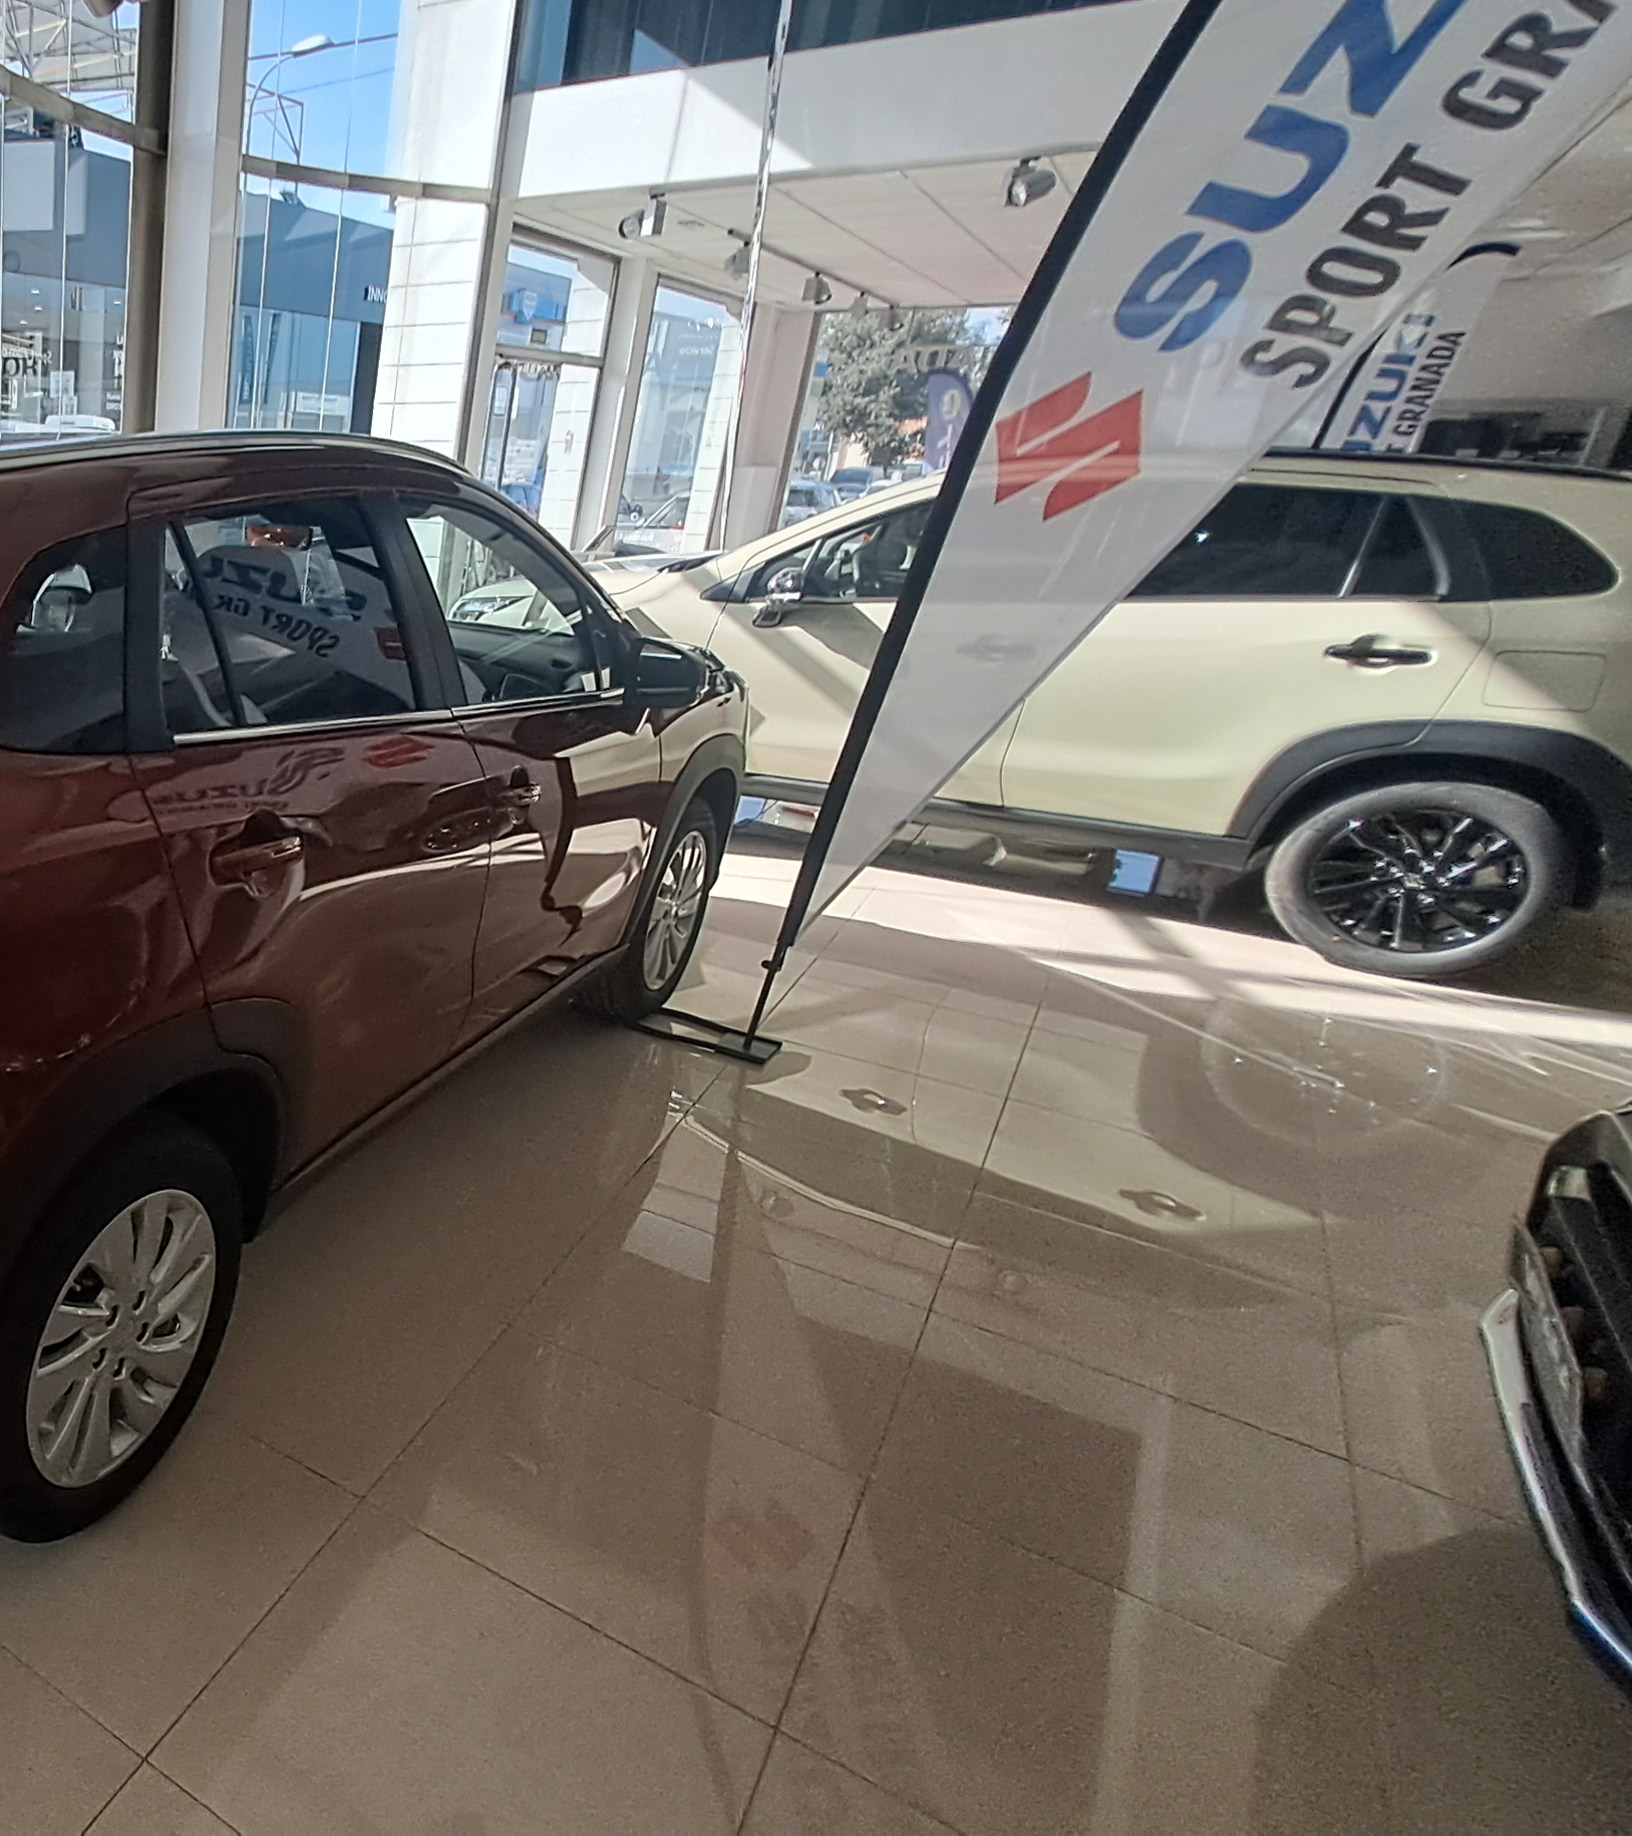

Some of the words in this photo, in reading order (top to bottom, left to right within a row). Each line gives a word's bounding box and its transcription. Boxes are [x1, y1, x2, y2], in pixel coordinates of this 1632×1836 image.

[1239, 141, 1473, 389] SPORT
[1440, 0, 1619, 131] GR
[1392, 330, 1467, 437] GRANADA
